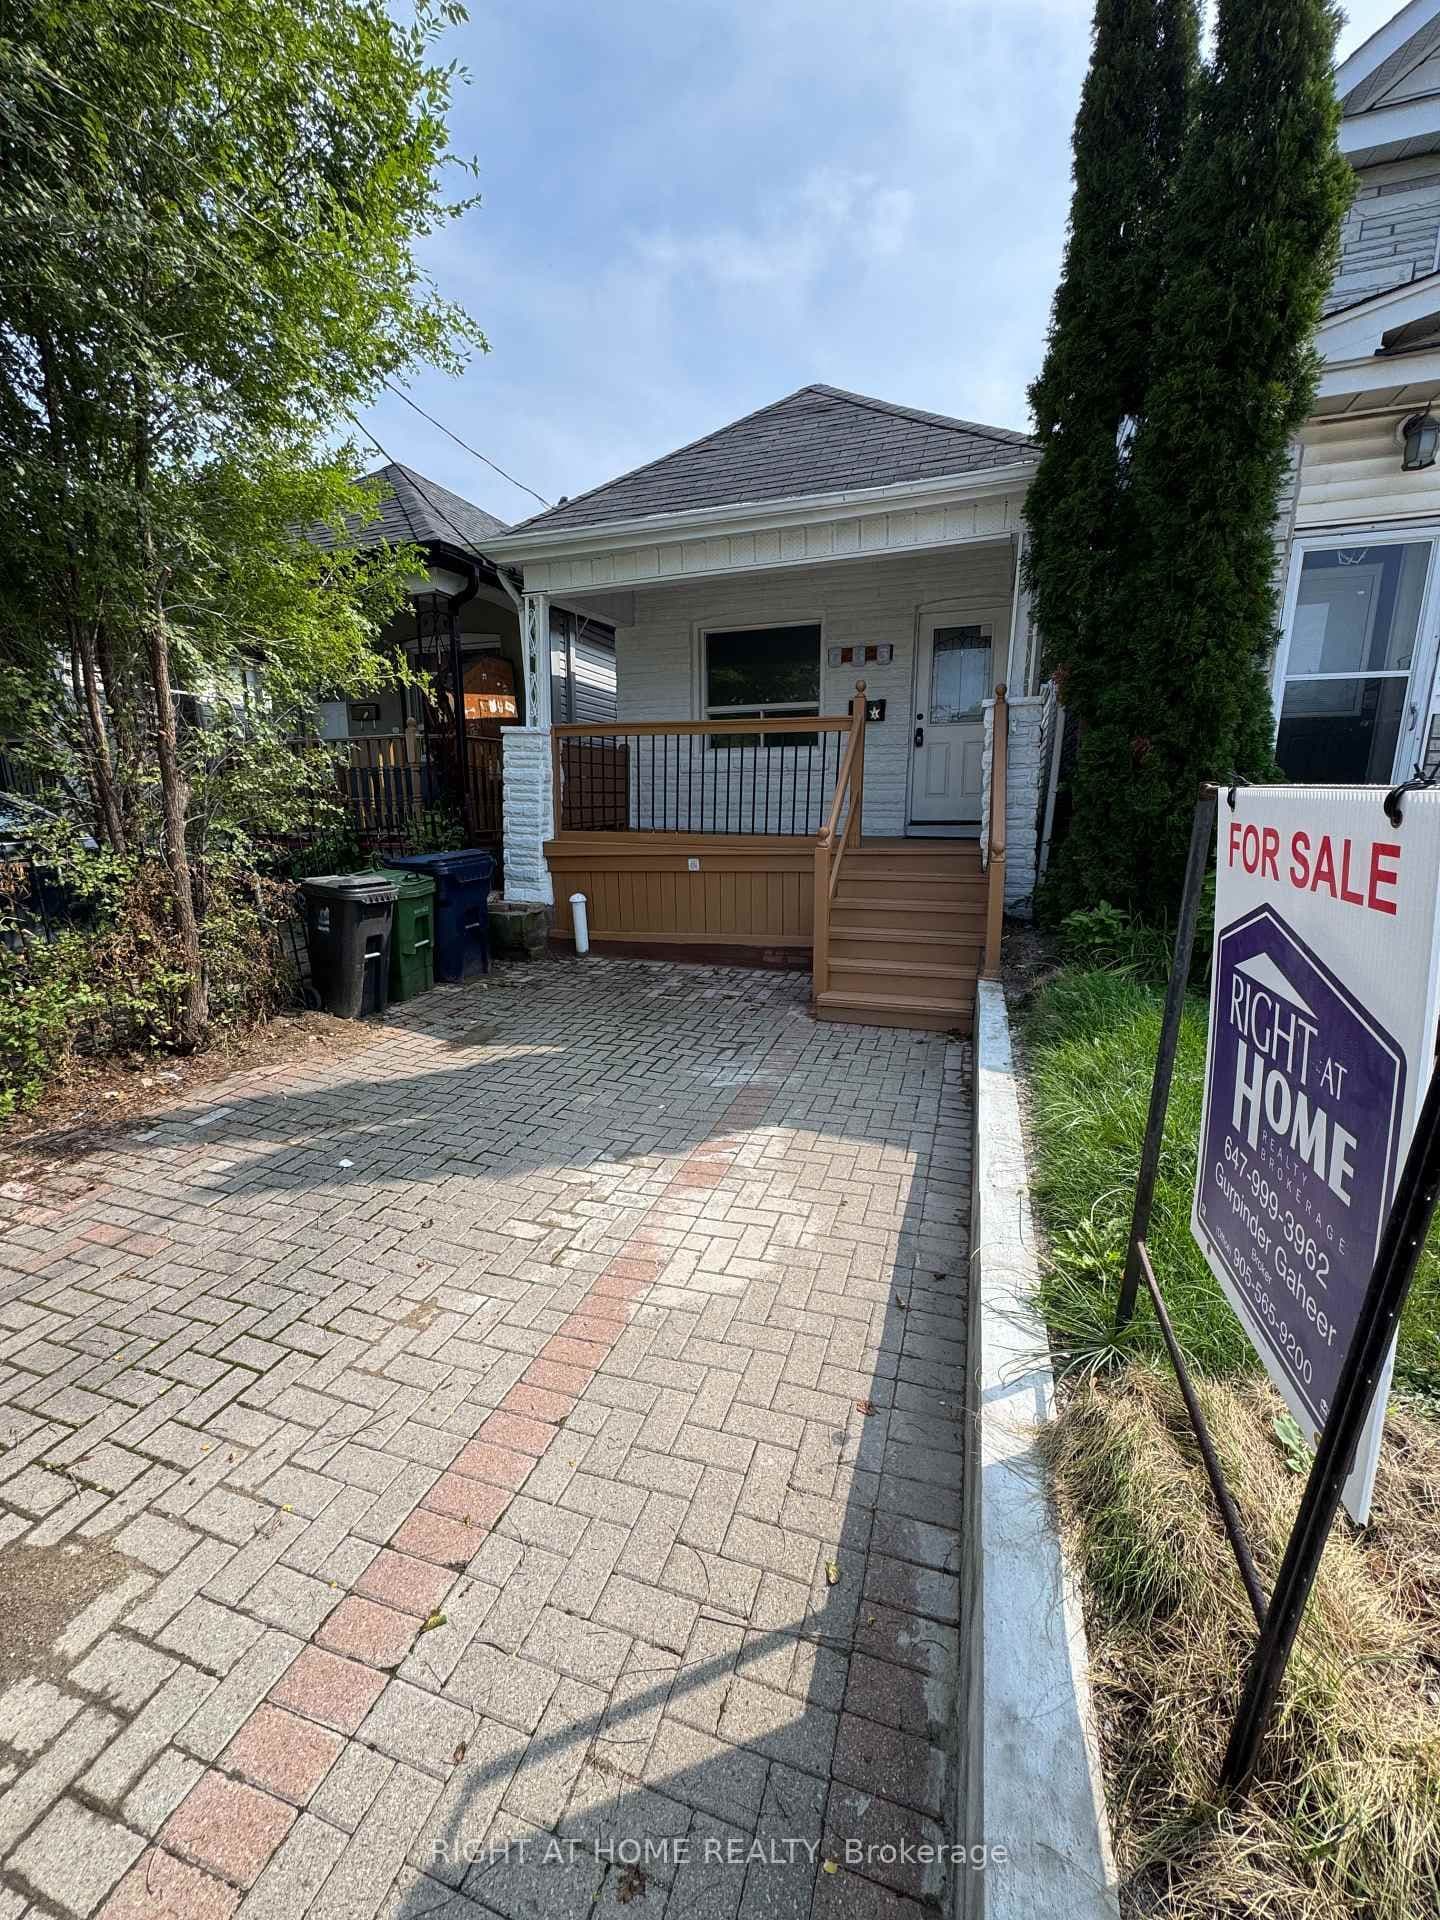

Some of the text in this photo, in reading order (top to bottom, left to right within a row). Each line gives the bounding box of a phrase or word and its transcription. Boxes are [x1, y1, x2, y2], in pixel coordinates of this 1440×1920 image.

[1229, 822, 1401, 916] FOR SALE
[1229, 973, 1348, 1100] RIGHT AT
[1232, 1038, 1357, 1208] HOME
[1262, 1129, 1308, 1187] REALTY
[1215, 1161, 1272, 1255] Gurpinder
[1275, 1245, 1337, 1347] Gaheer
[1224, 1135, 1330, 1290] 647-999-3962
[1260, 1147, 1347, 1256] BROKERAGE
[1233, 1247, 1313, 1385] 905-565-9200
